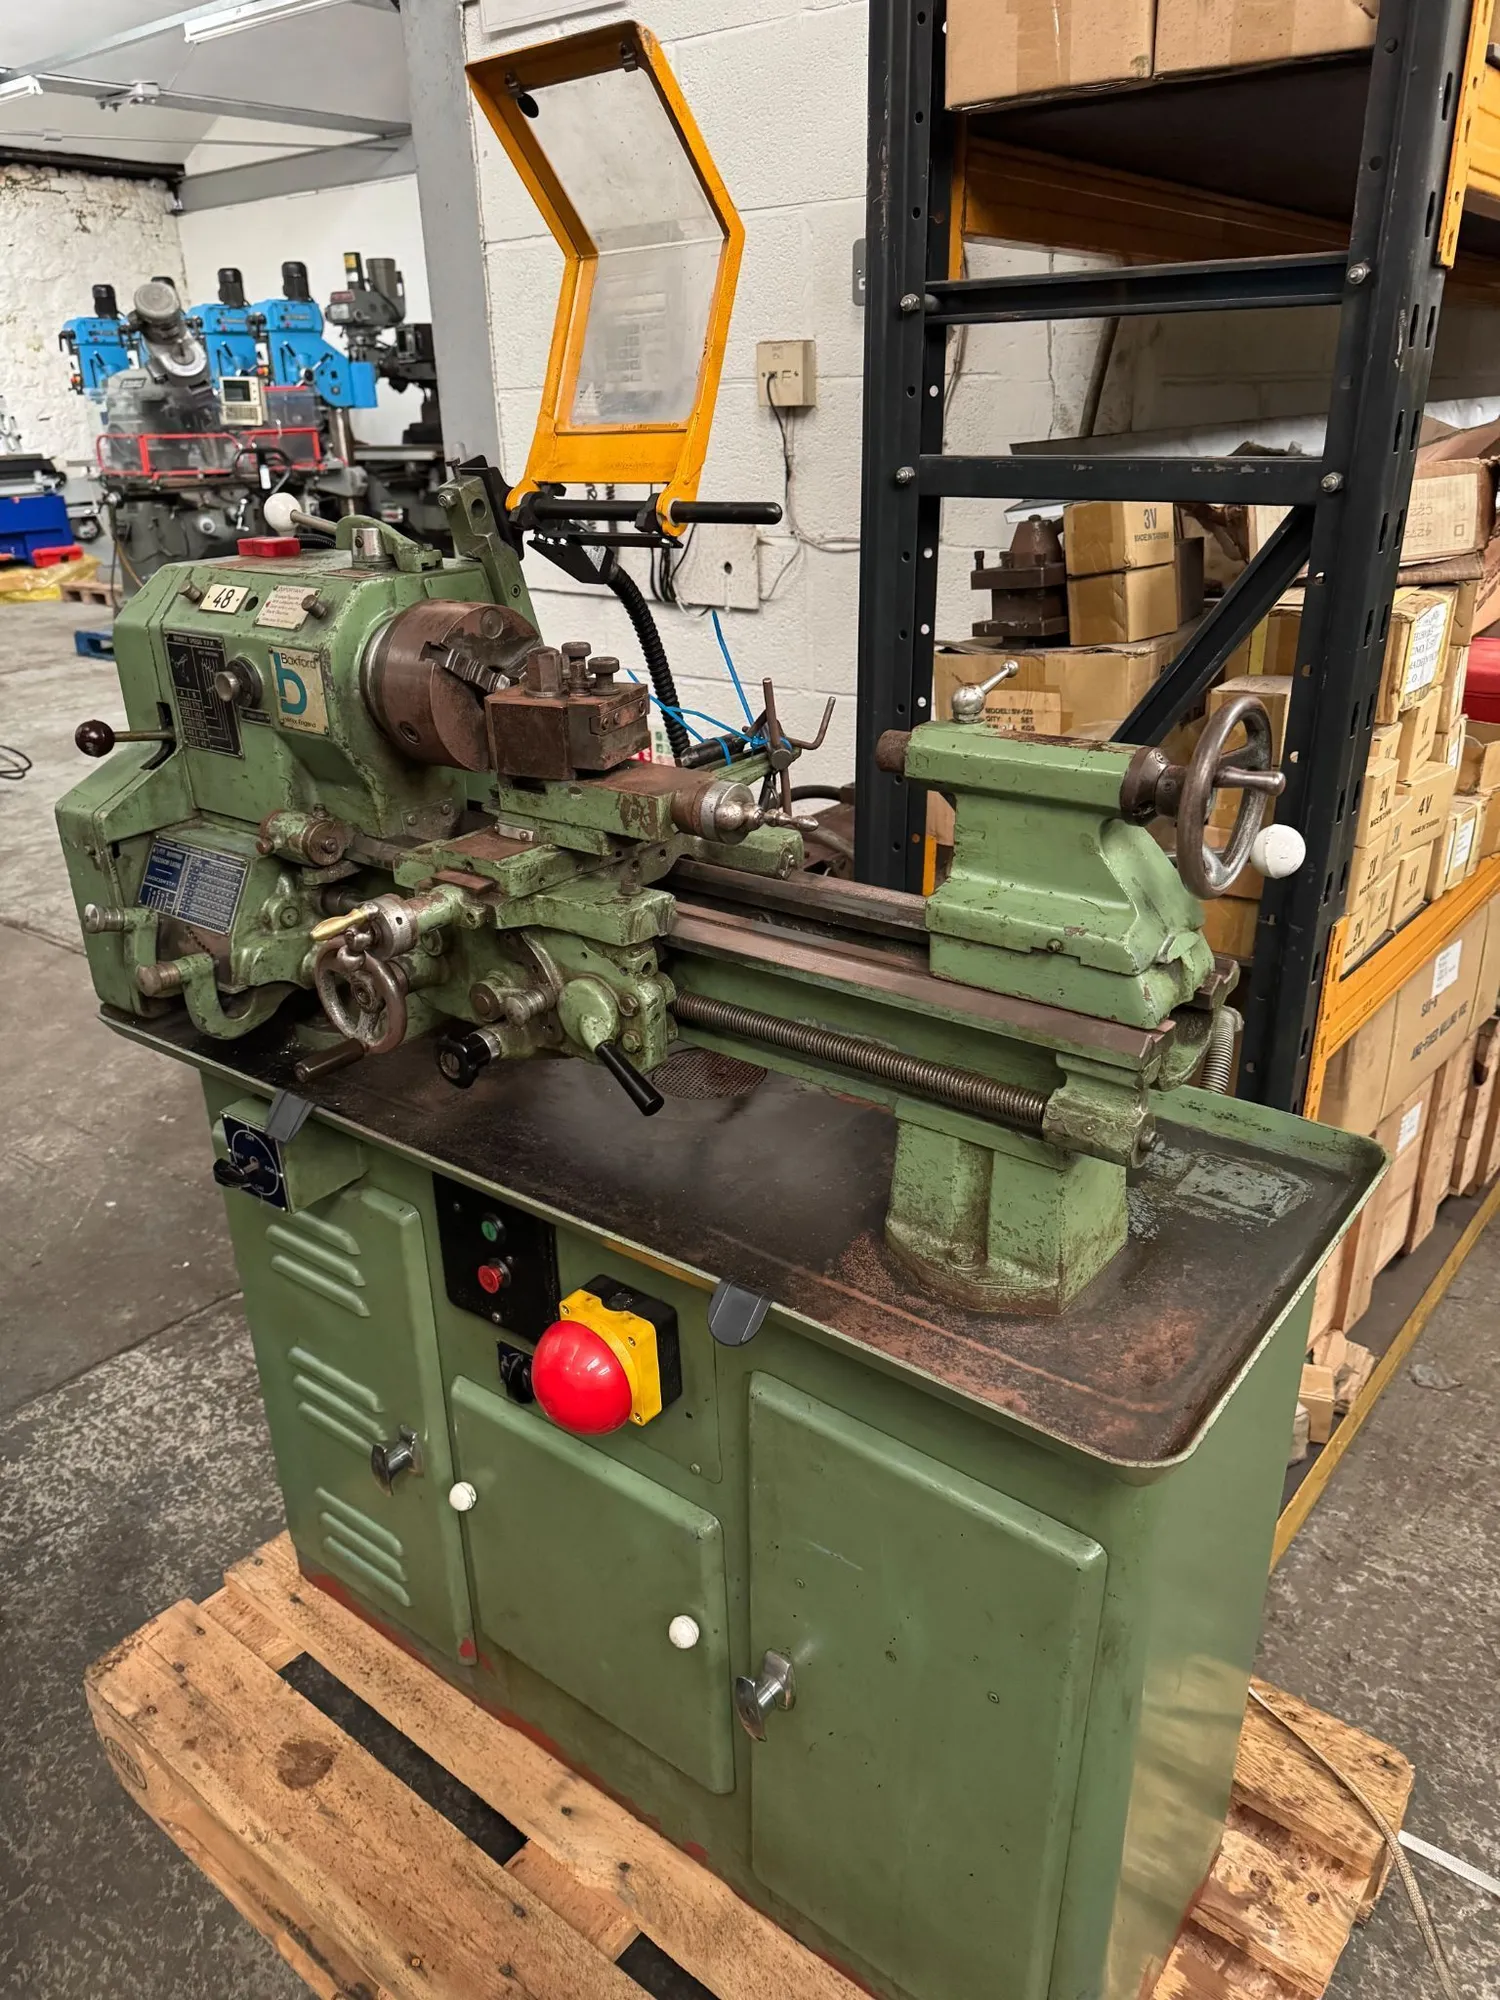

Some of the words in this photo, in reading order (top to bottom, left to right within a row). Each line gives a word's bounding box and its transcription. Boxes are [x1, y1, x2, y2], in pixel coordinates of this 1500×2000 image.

[1143, 508, 1157, 530] 3V
[212, 587, 236, 609] 48
[280, 652, 317, 669] Boxford
[1379, 786, 1390, 812] 2V
[1417, 794, 1434, 816] 4V
